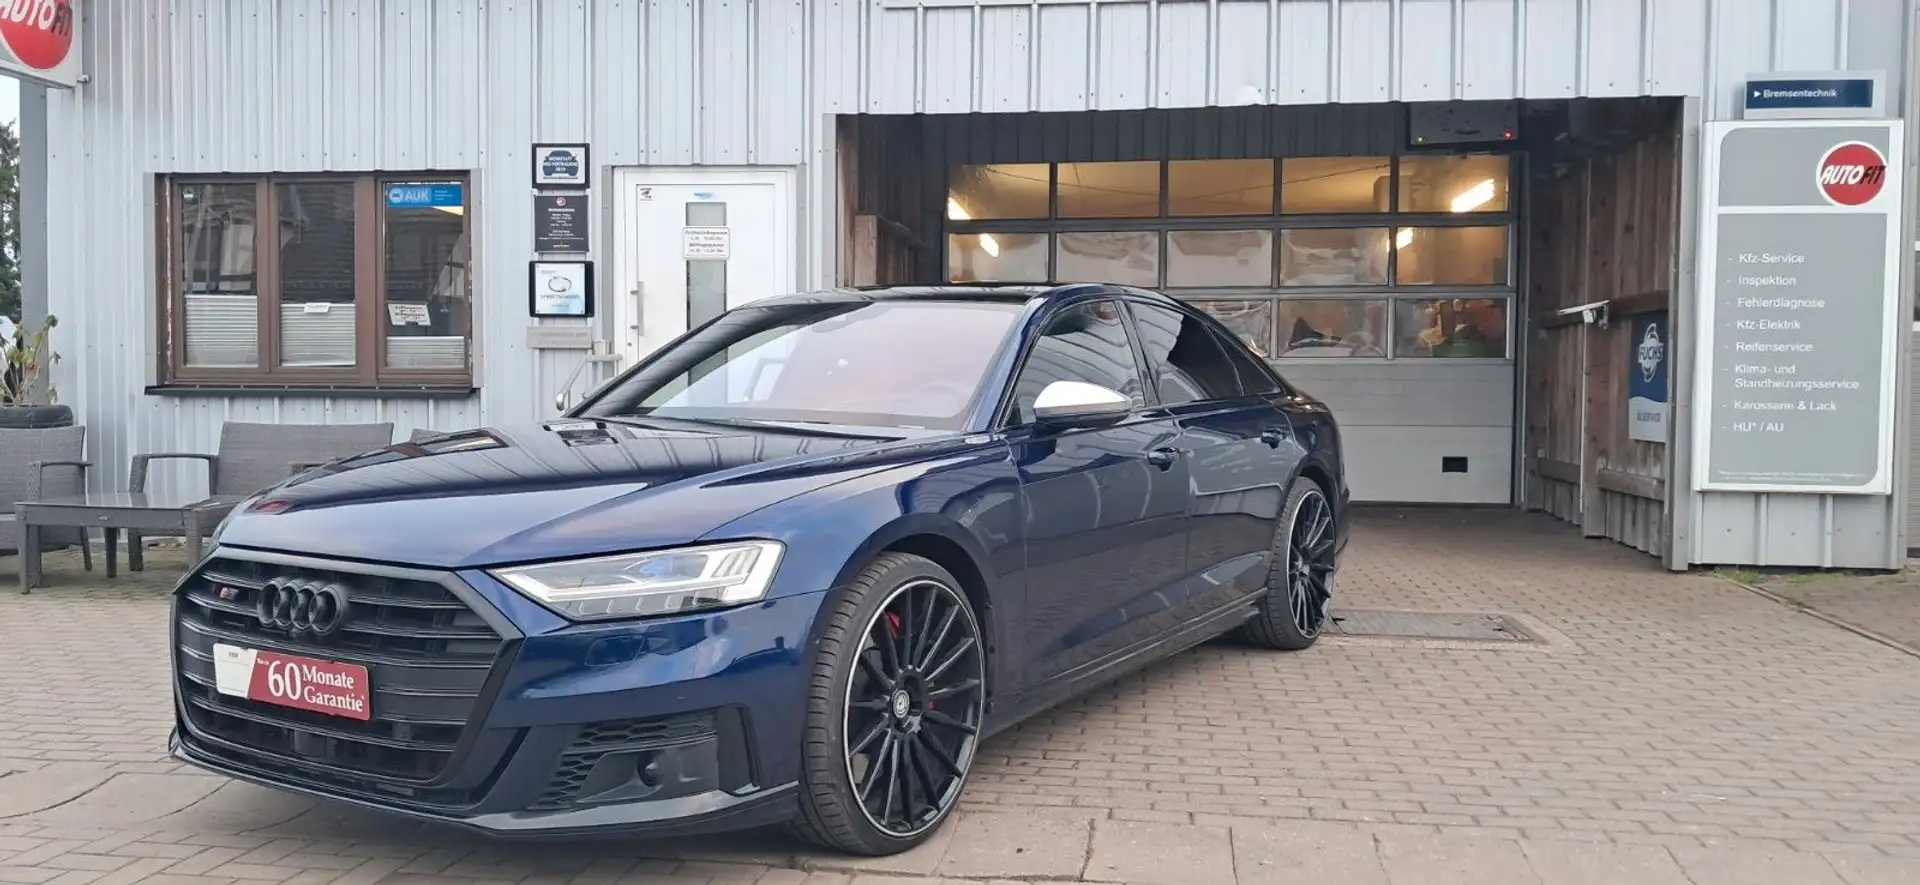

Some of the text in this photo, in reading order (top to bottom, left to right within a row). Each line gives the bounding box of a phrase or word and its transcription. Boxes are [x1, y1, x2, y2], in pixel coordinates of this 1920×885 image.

[1763, 88, 1838, 98] Bremsentechnik
[1820, 164, 1887, 185] AUTOFIT
[1739, 253, 1805, 264] Kfz-Service
[1738, 275, 1797, 287] Inspektion
[1737, 297, 1826, 310] Fehlerdiagnose
[1736, 319, 1802, 330] Kfz-Elektrik
[1736, 341, 1814, 352] Reifenservice
[1638, 343, 1665, 363] FUCHS
[1735, 364, 1796, 374] Klima- und
[1734, 378, 1860, 391] Standheizungsservice
[1734, 401, 1836, 412] Karosserie & Lack
[1766, 423, 1784, 432] AU
[268, 660, 354, 701] 60 Monate
